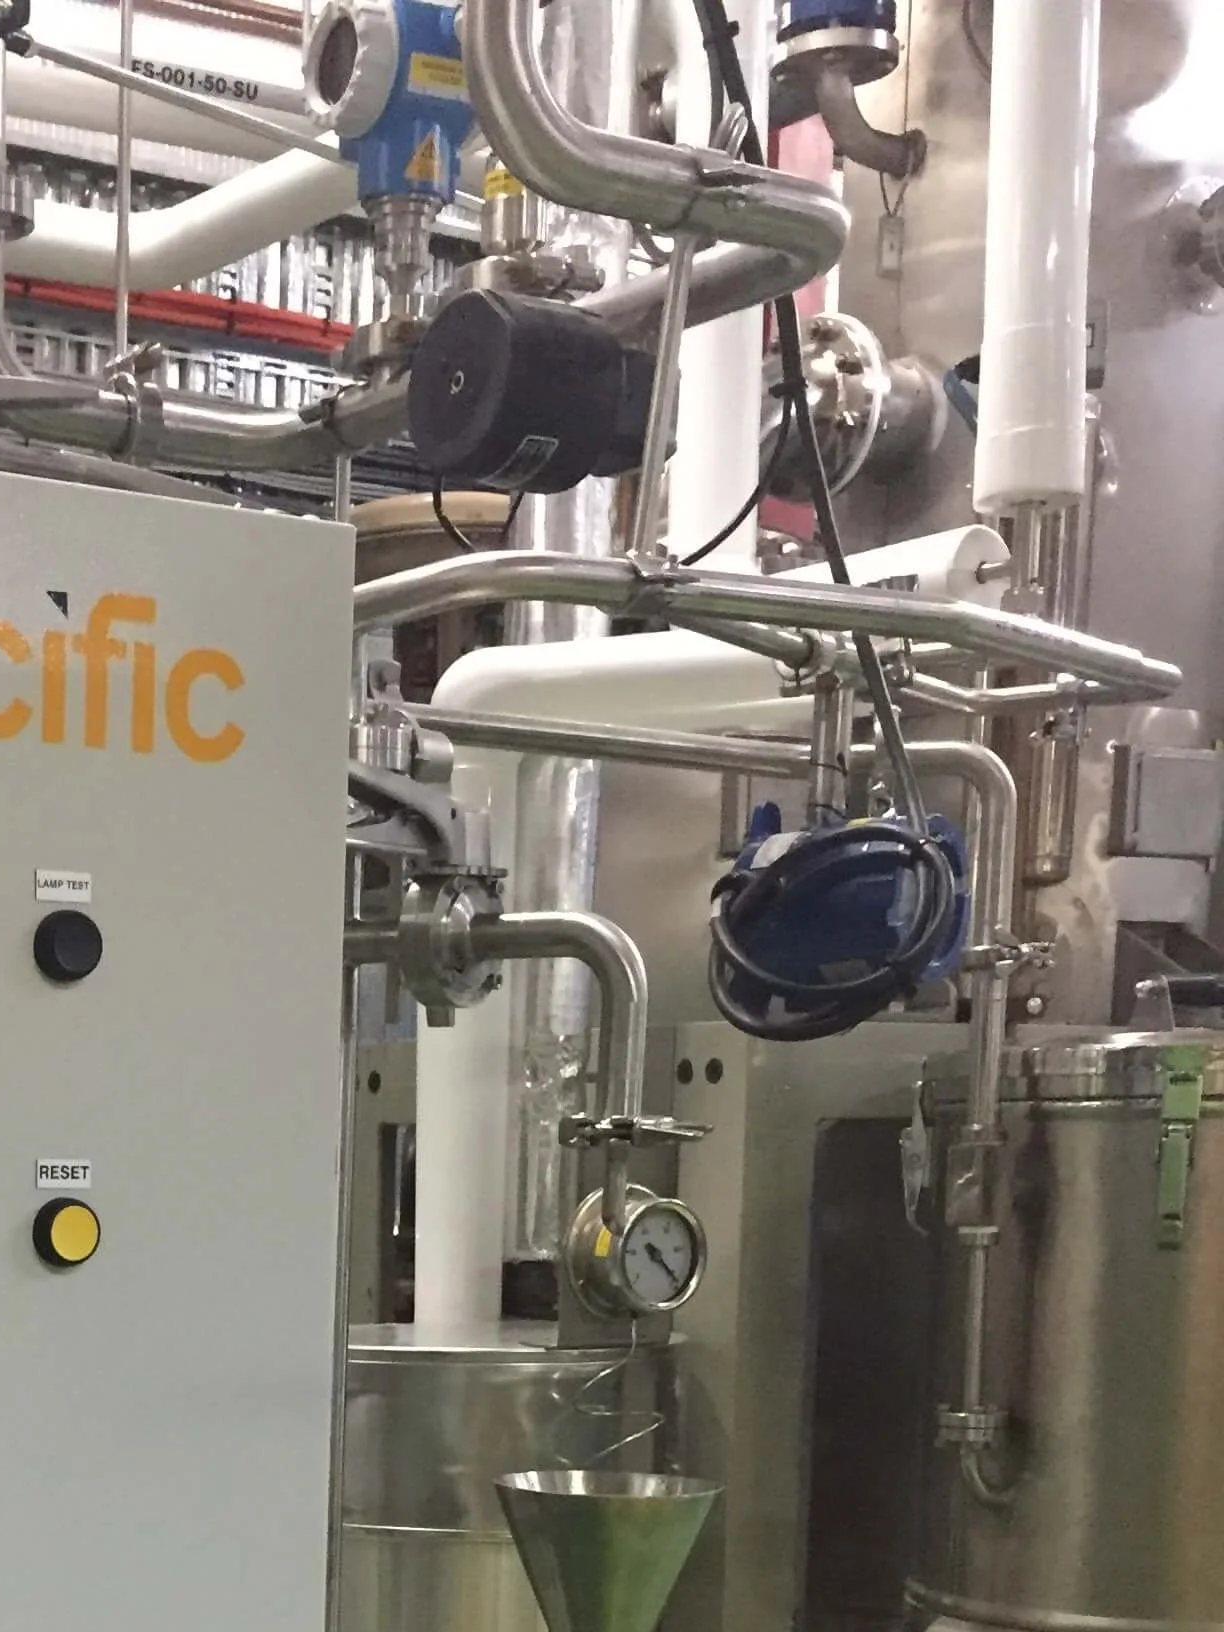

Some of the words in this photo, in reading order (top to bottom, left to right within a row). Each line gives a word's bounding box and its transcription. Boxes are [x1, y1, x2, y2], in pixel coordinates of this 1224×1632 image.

[37, 879, 64, 889] LAMP
[67, 880, 90, 891] TEST
[39, 1165, 90, 1180] RESET
